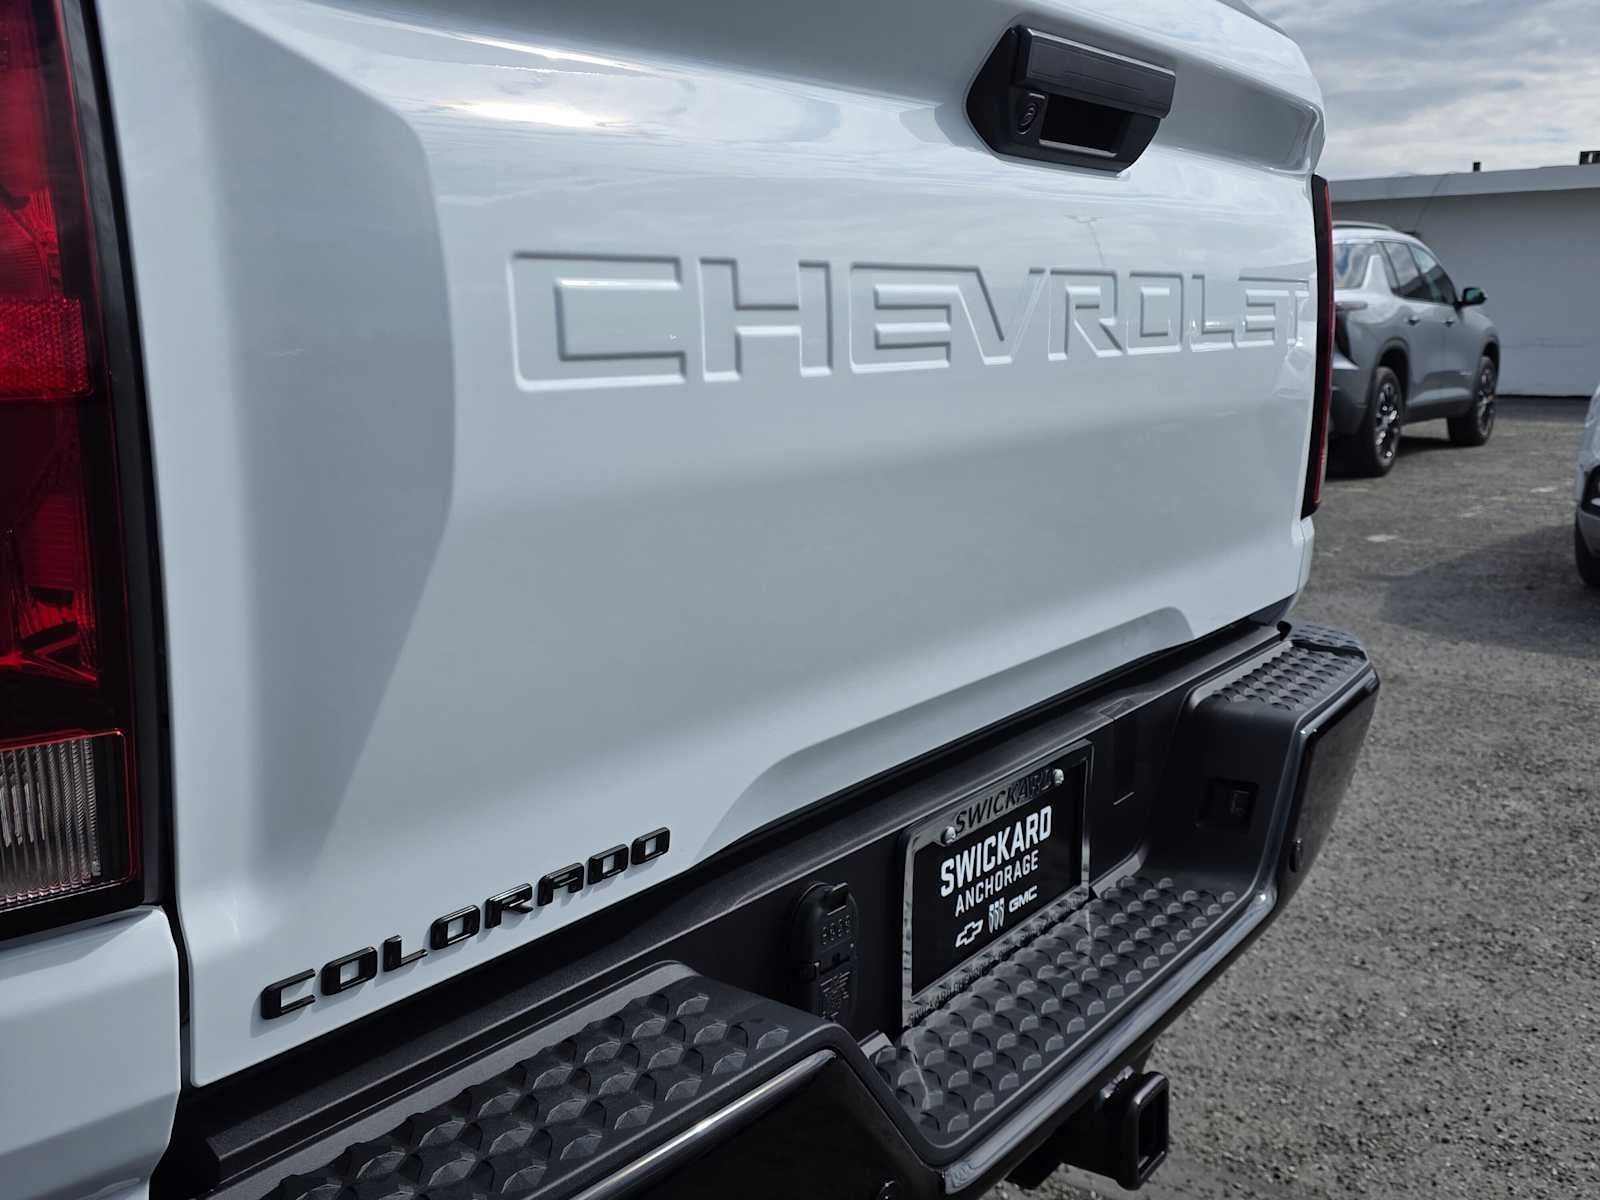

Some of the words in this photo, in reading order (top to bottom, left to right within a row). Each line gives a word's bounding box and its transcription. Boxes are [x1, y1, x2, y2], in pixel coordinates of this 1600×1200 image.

[507, 250, 1310, 393] CHEVROLET
[940, 805, 1052, 897] SWICKARD
[955, 850, 1039, 917] ANCHORAGE
[261, 827, 671, 1020] COLORADO
[1008, 885, 1038, 913] GMC
